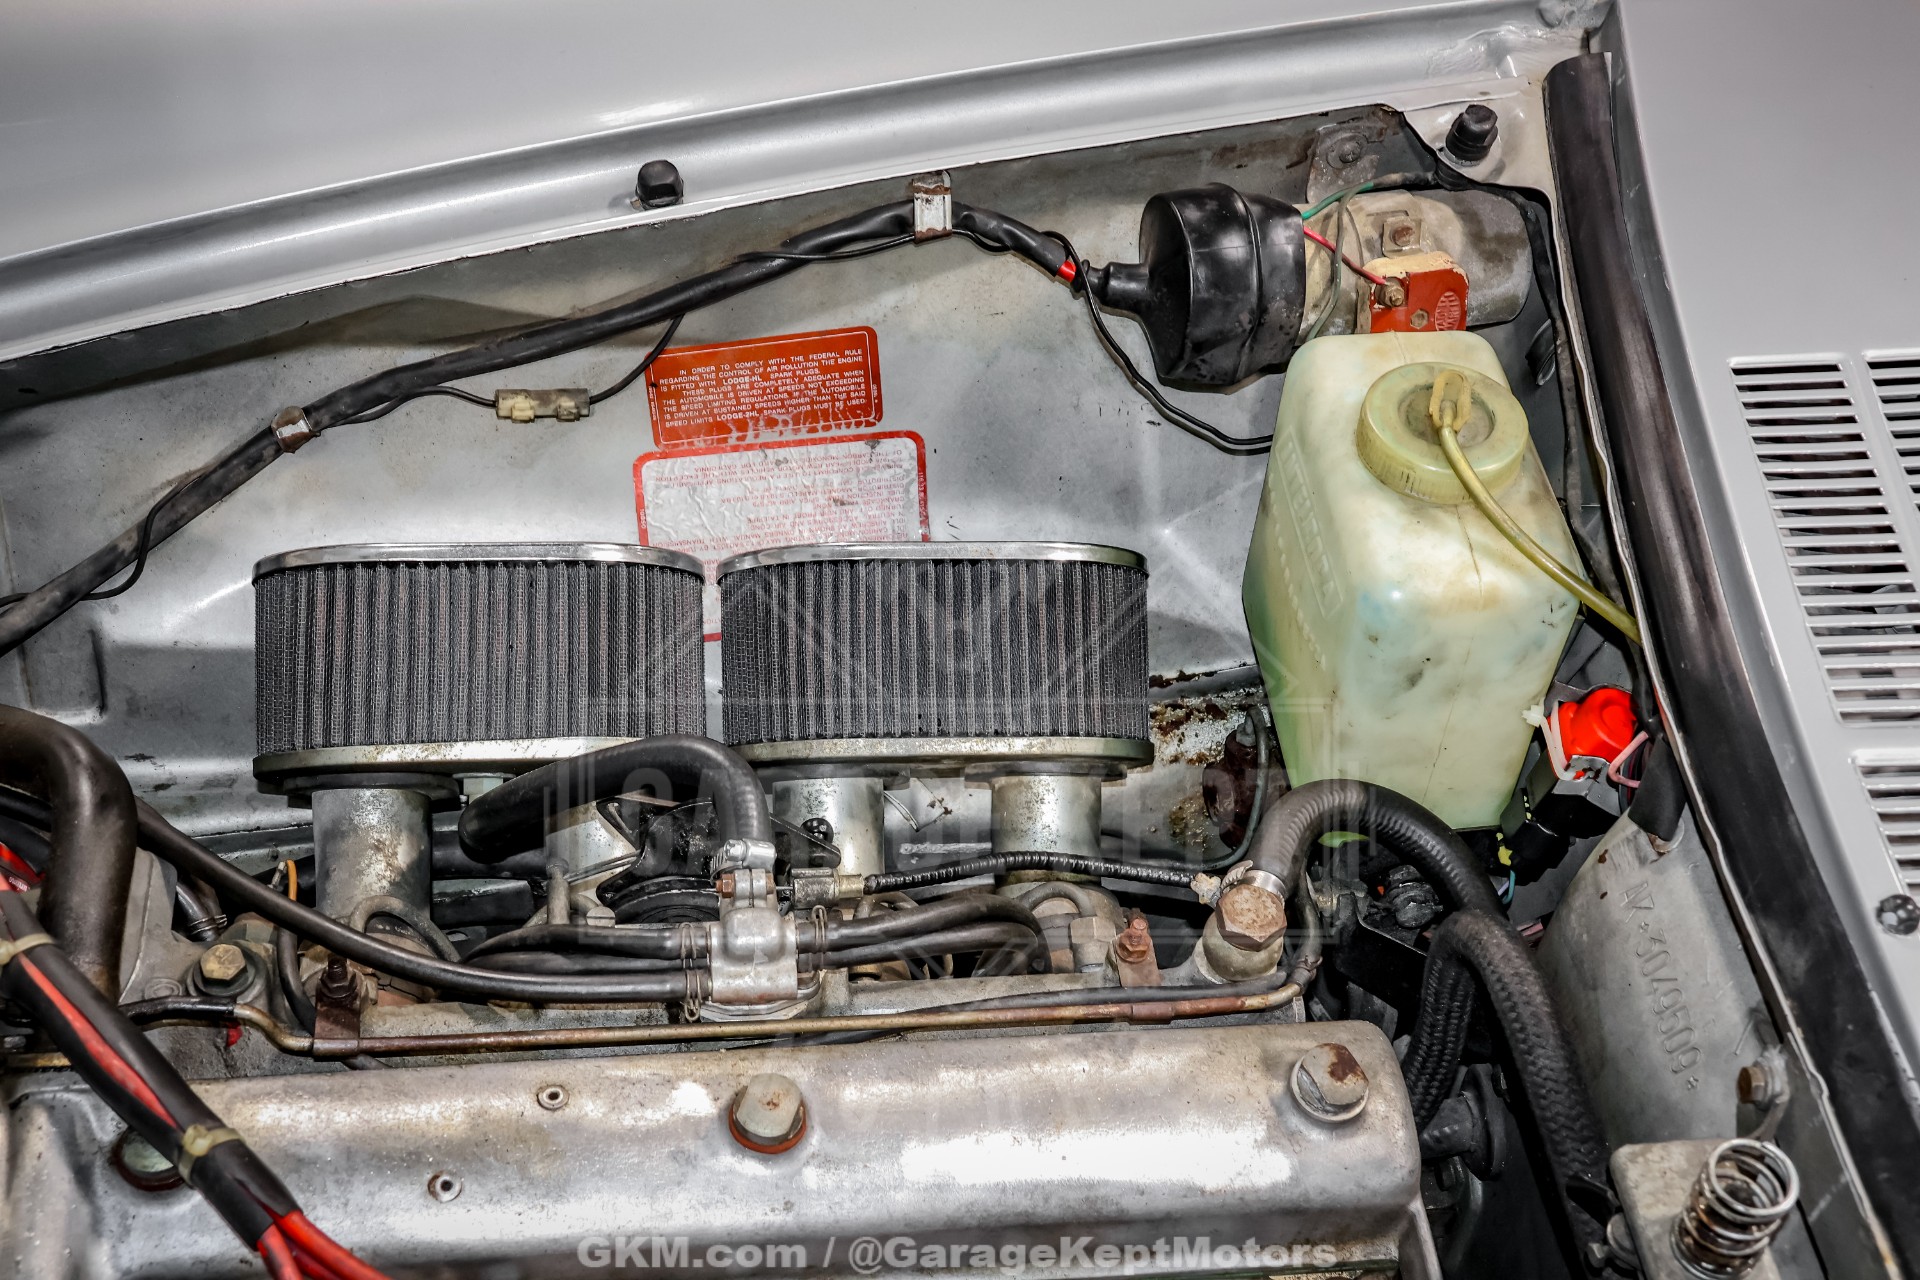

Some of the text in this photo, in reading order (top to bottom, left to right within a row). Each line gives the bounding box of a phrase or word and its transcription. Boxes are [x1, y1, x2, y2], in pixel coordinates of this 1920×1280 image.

[660, 375, 699, 385] REGARDING
[719, 369, 751, 377] CONTROL
[781, 361, 821, 371] POLLUTION
[838, 356, 862, 364] ENGINE
[692, 366, 715, 374] ORDER
[735, 360, 763, 369] COMPLY
[810, 352, 839, 360] FEDERAL
[671, 383, 695, 391] FITTED
[680, 393, 724, 404] AUTOMOBILE
[779, 384, 805, 392] SPEEDS
[826, 377, 864, 386] EXCEEDING
[754, 378, 799, 389] COMPLETELY
[804, 373, 840, 382] ADEQUATE
[681, 403, 703, 411] SPEED
[708, 399, 736, 407] LIMITING
[822, 384, 865, 394] AUTOMOBILE
[714, 404, 751, 414] SUSTAINED
[755, 401, 781, 409] SPEEDS
[785, 398, 810, 406] HIGHER
[717, 410, 759, 421] LODGE-2HL
[763, 408, 785, 416] SPARK
